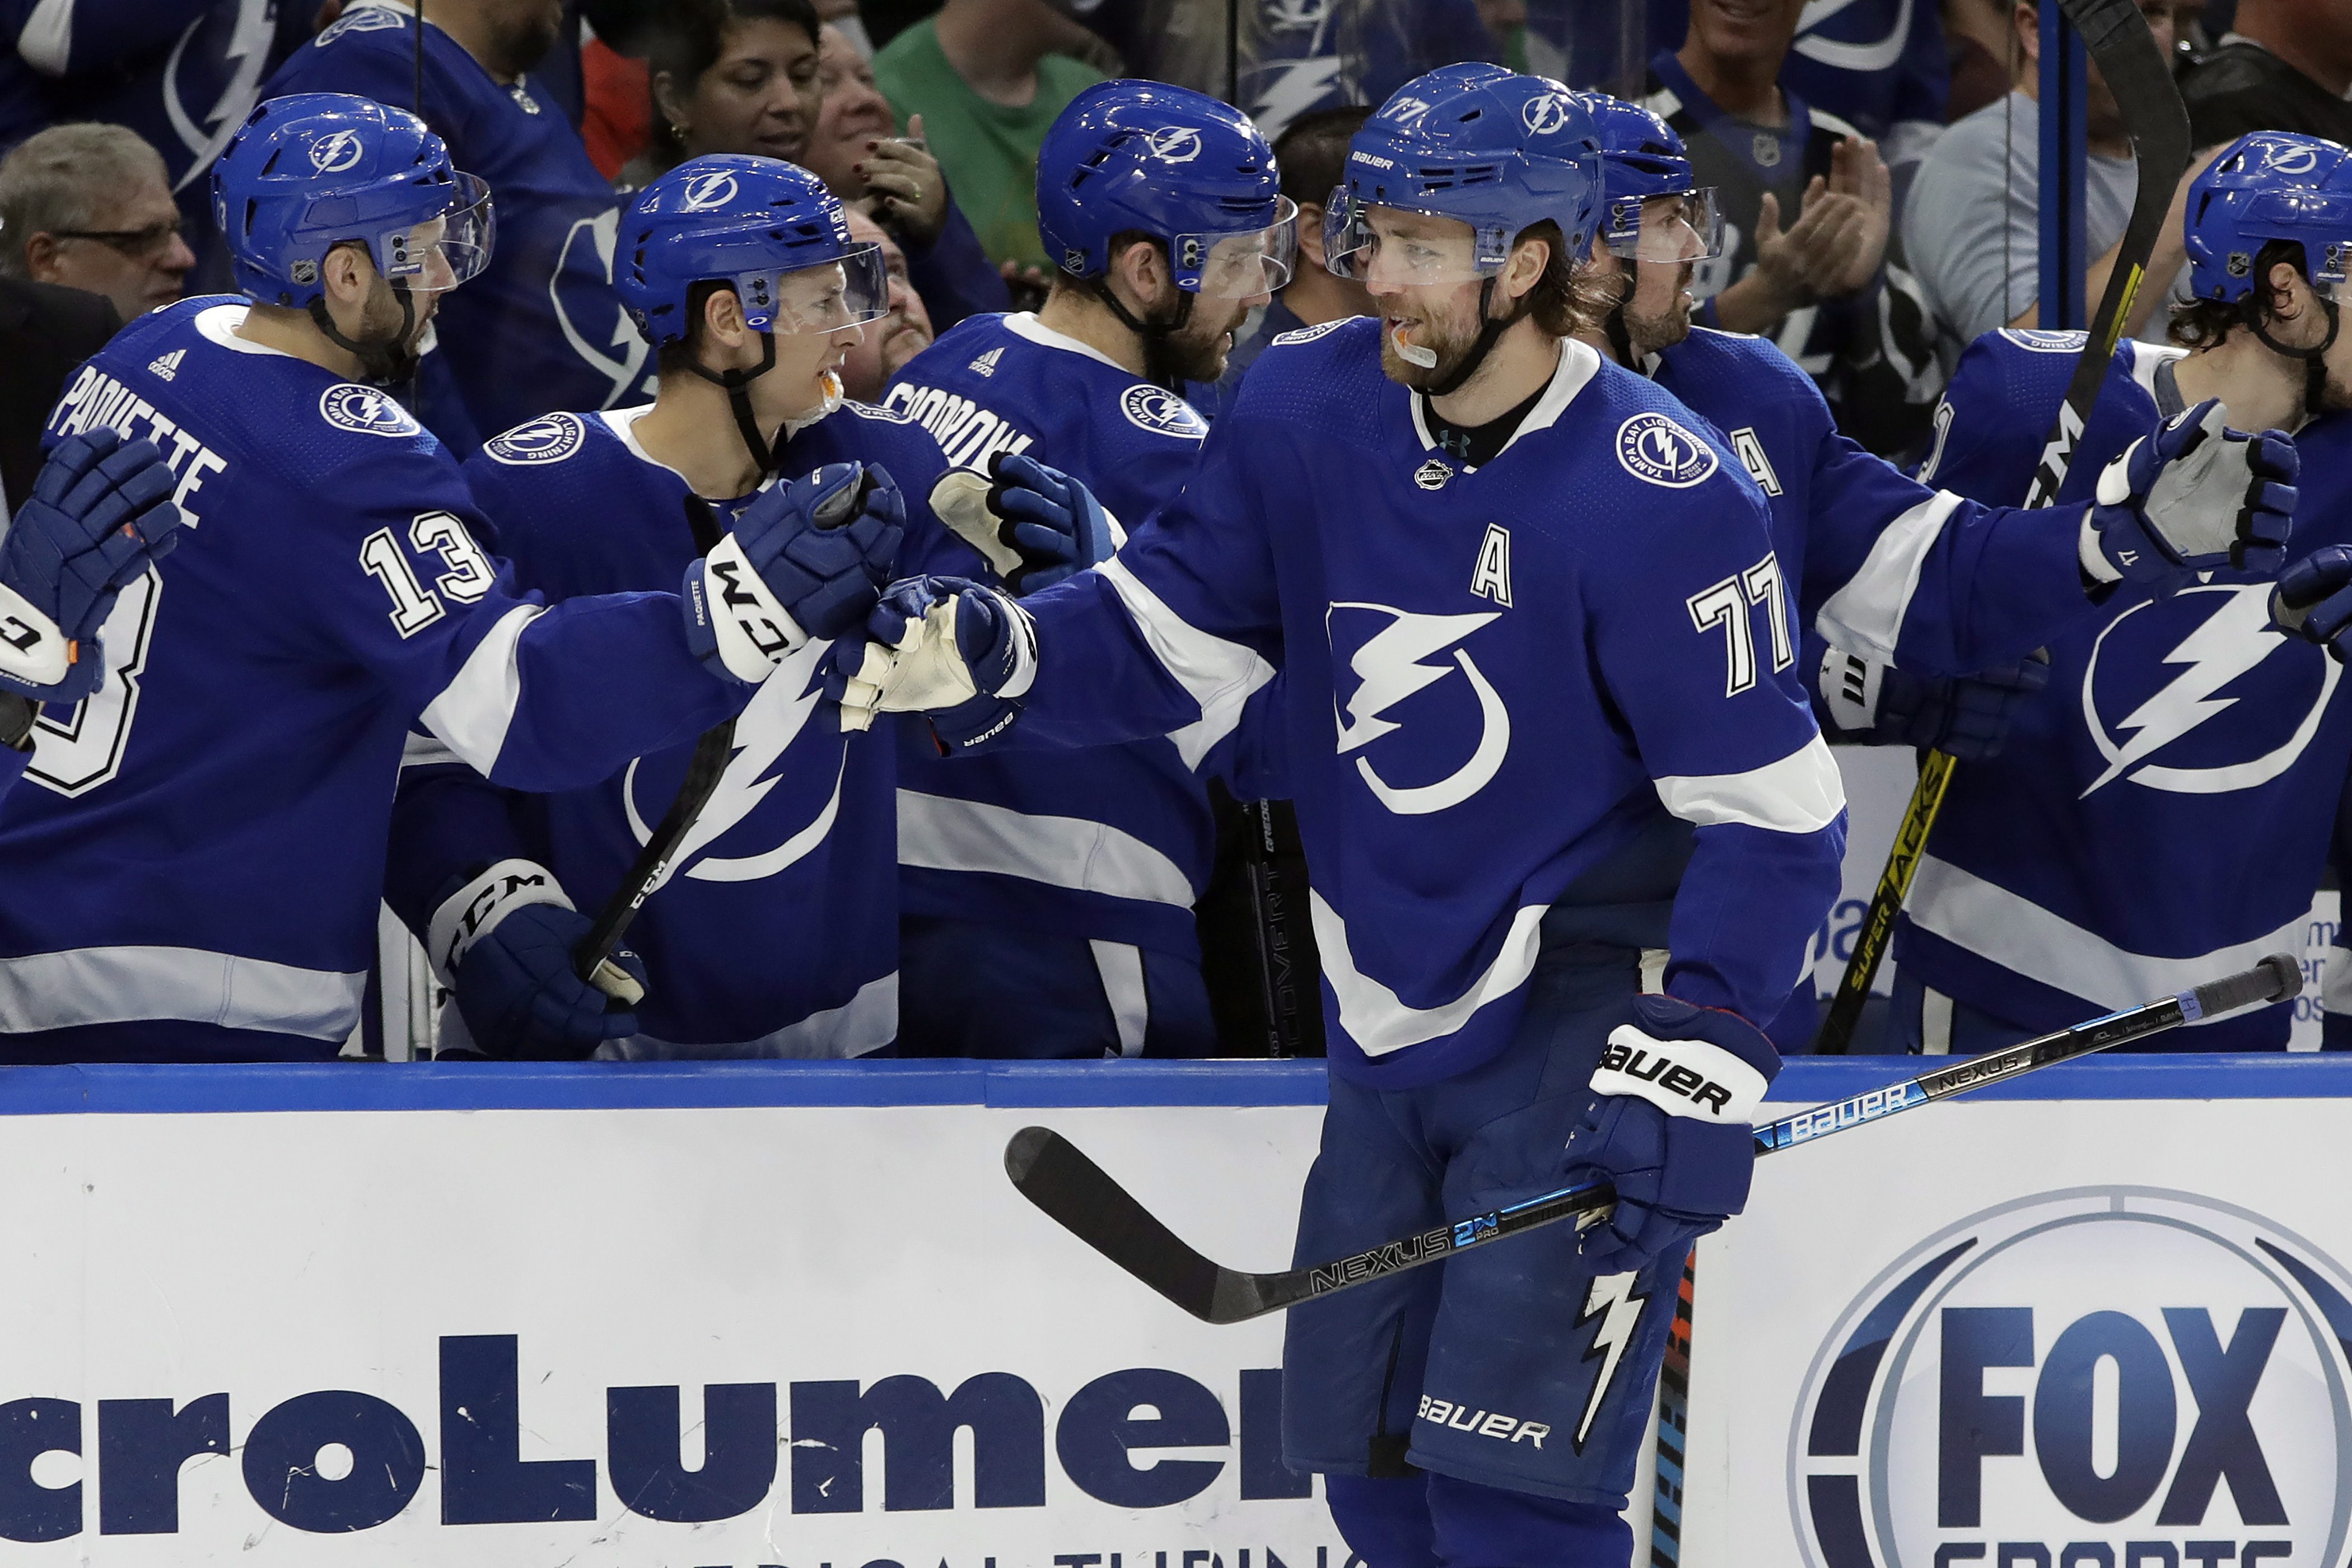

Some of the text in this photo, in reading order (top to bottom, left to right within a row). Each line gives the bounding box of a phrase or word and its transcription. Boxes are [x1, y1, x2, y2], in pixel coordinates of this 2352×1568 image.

[1382, 97, 1430, 123] 77
[1351, 150, 1394, 170] BAUER
[147, 361, 176, 381] adidas
[328, 388, 356, 426] TAMPA BAY
[1129, 396, 1152, 424] TAMPA
[527, 422, 577, 460] LIGHTNING
[1624, 418, 1709, 479] TAMPA BAY LIGHTNING
[1730, 426, 1795, 497] A
[358, 510, 497, 640] 13
[1469, 522, 1514, 609] A
[690, 580, 706, 626] PAQUETTE
[1686, 550, 1806, 699] 77
[963, 711, 1014, 747] BAUER
[630, 860, 667, 910] CCM
[1851, 903, 1891, 992] SUPER
[1791, 1054, 2019, 1143] BAUER NEXUS
[1309, 1228, 1452, 1295] NEXUS
[1475, 1226, 1500, 1241] PRO
[1417, 1394, 1551, 1450] BAUER
[1938, 1307, 2290, 1528] FOX
